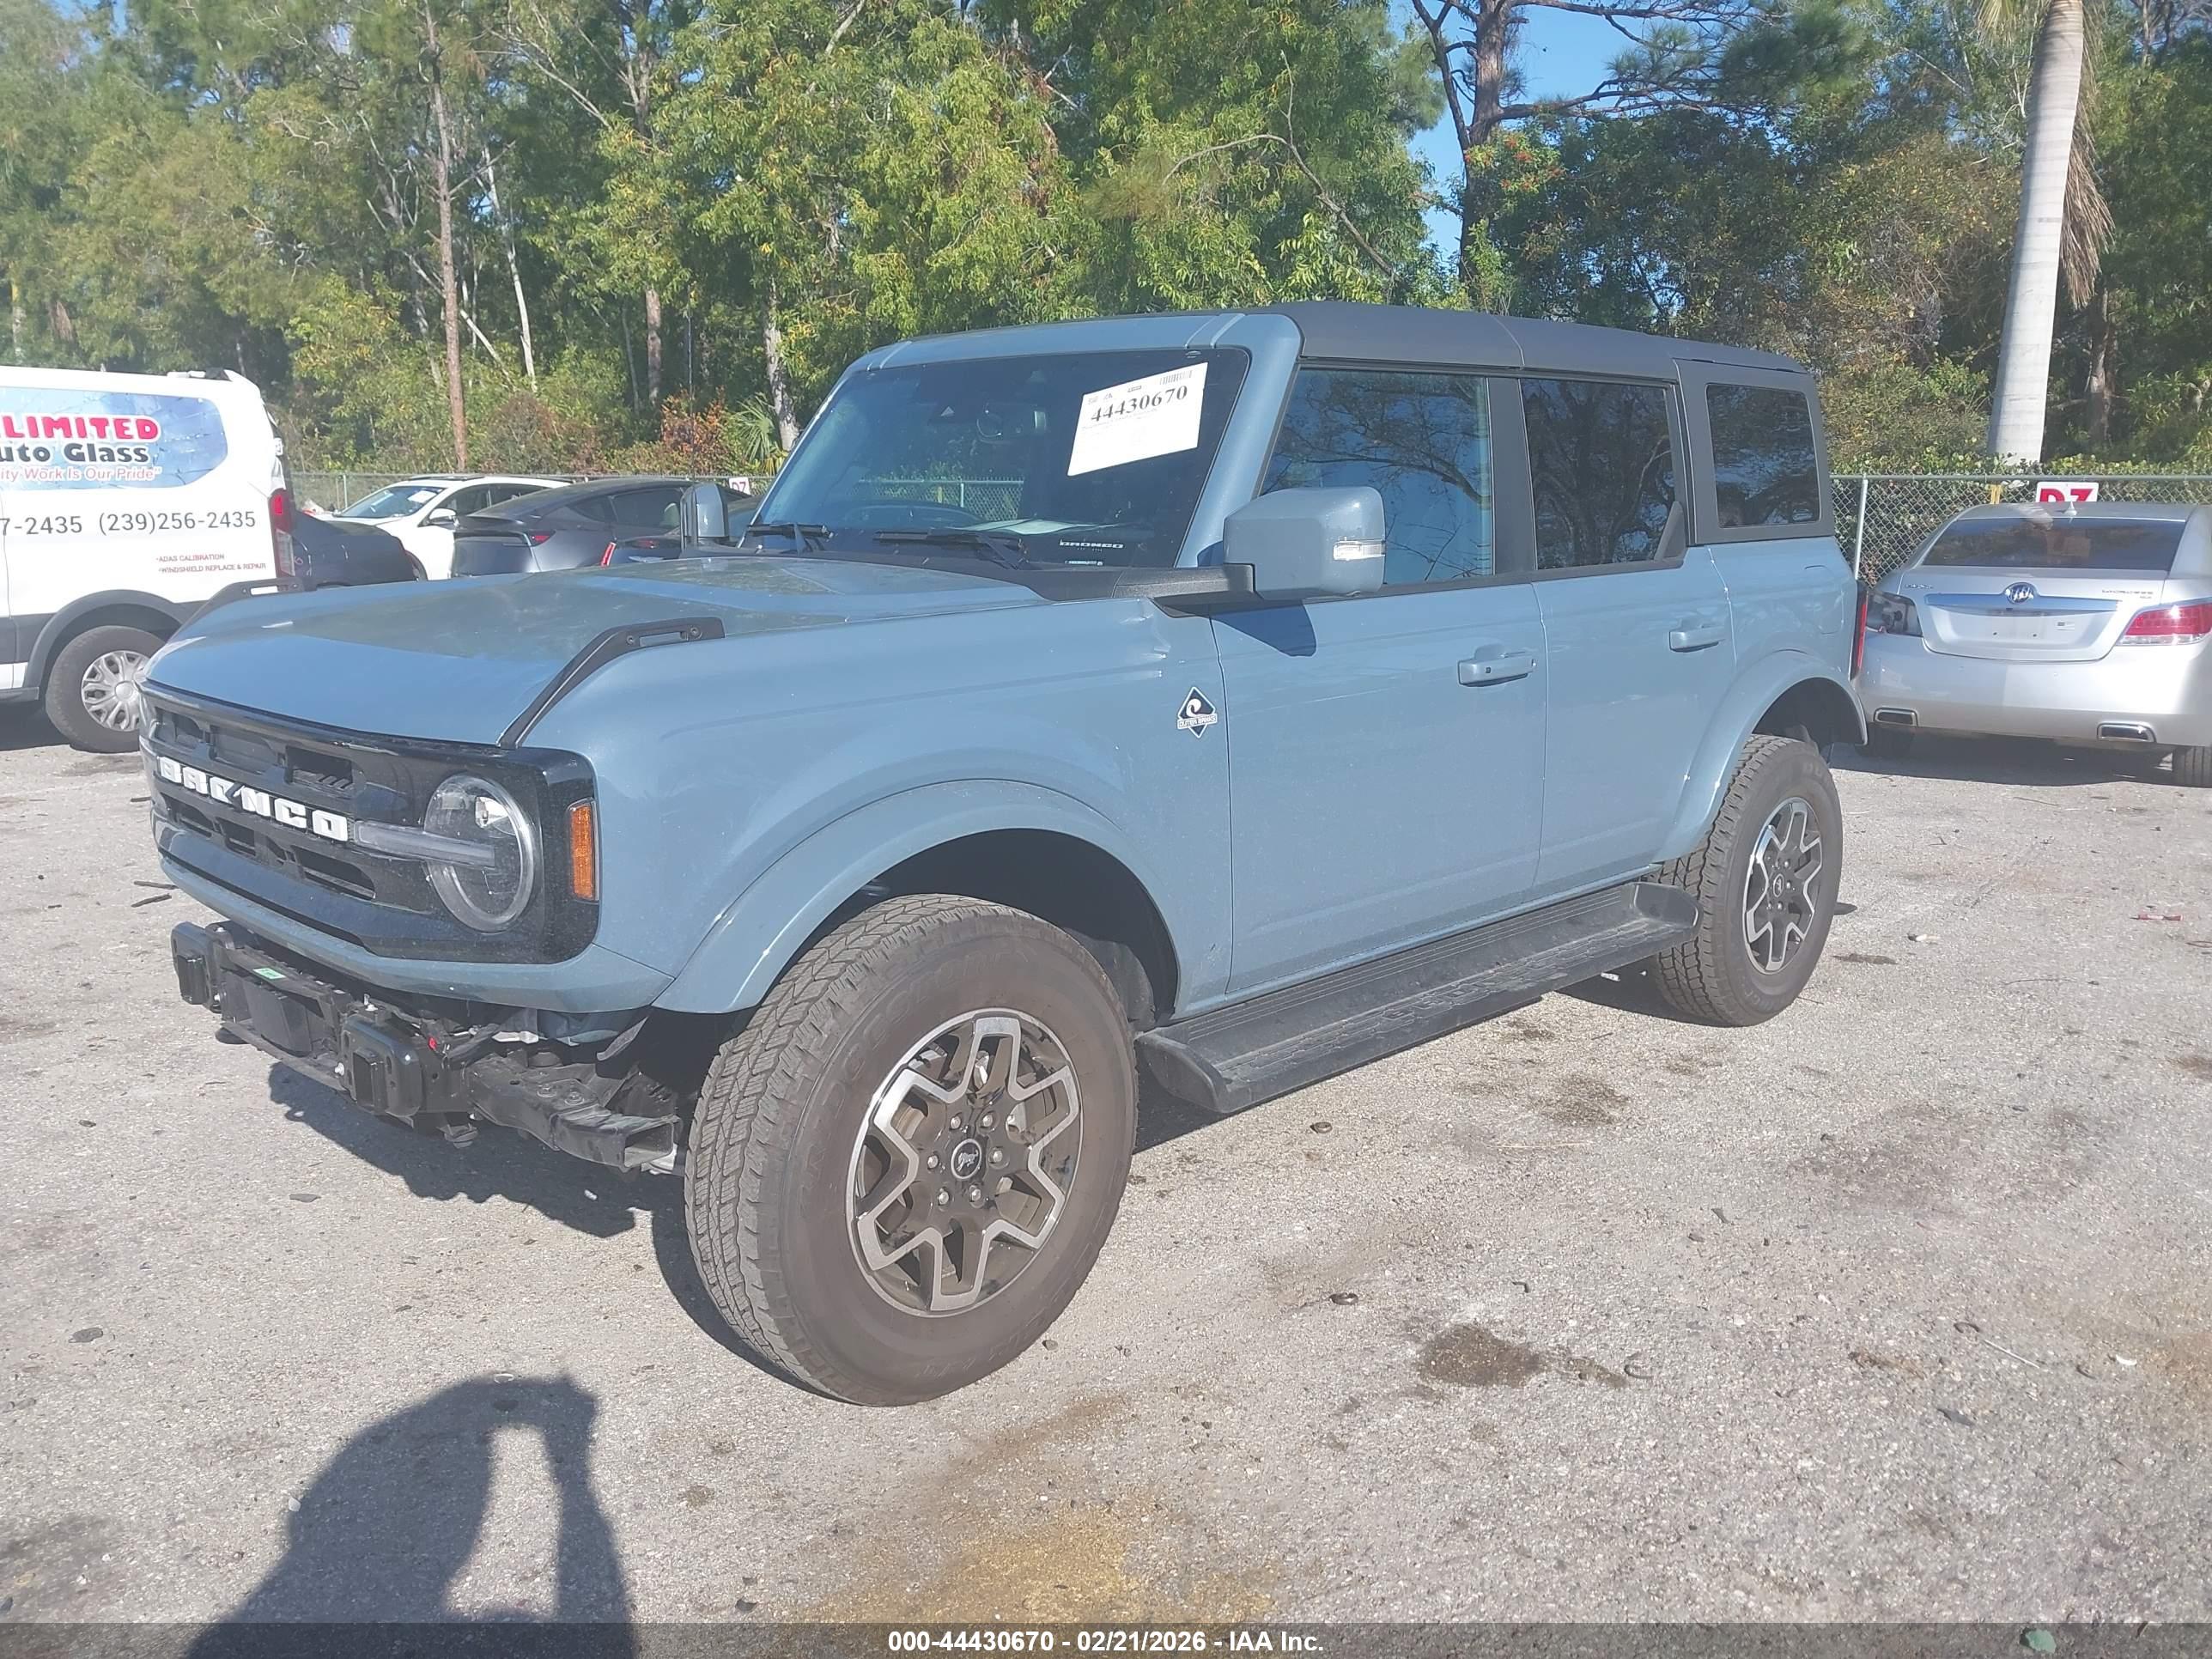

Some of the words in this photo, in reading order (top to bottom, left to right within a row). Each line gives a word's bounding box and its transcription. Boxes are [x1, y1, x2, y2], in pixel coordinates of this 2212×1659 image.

[1090, 385, 1188, 422] 44430670
[63, 442, 149, 463] Glass
[24, 467, 63, 480] Work
[68, 467, 79, 479] Is
[85, 467, 112, 479] Our
[99, 511, 256, 536] (239)256-2435
